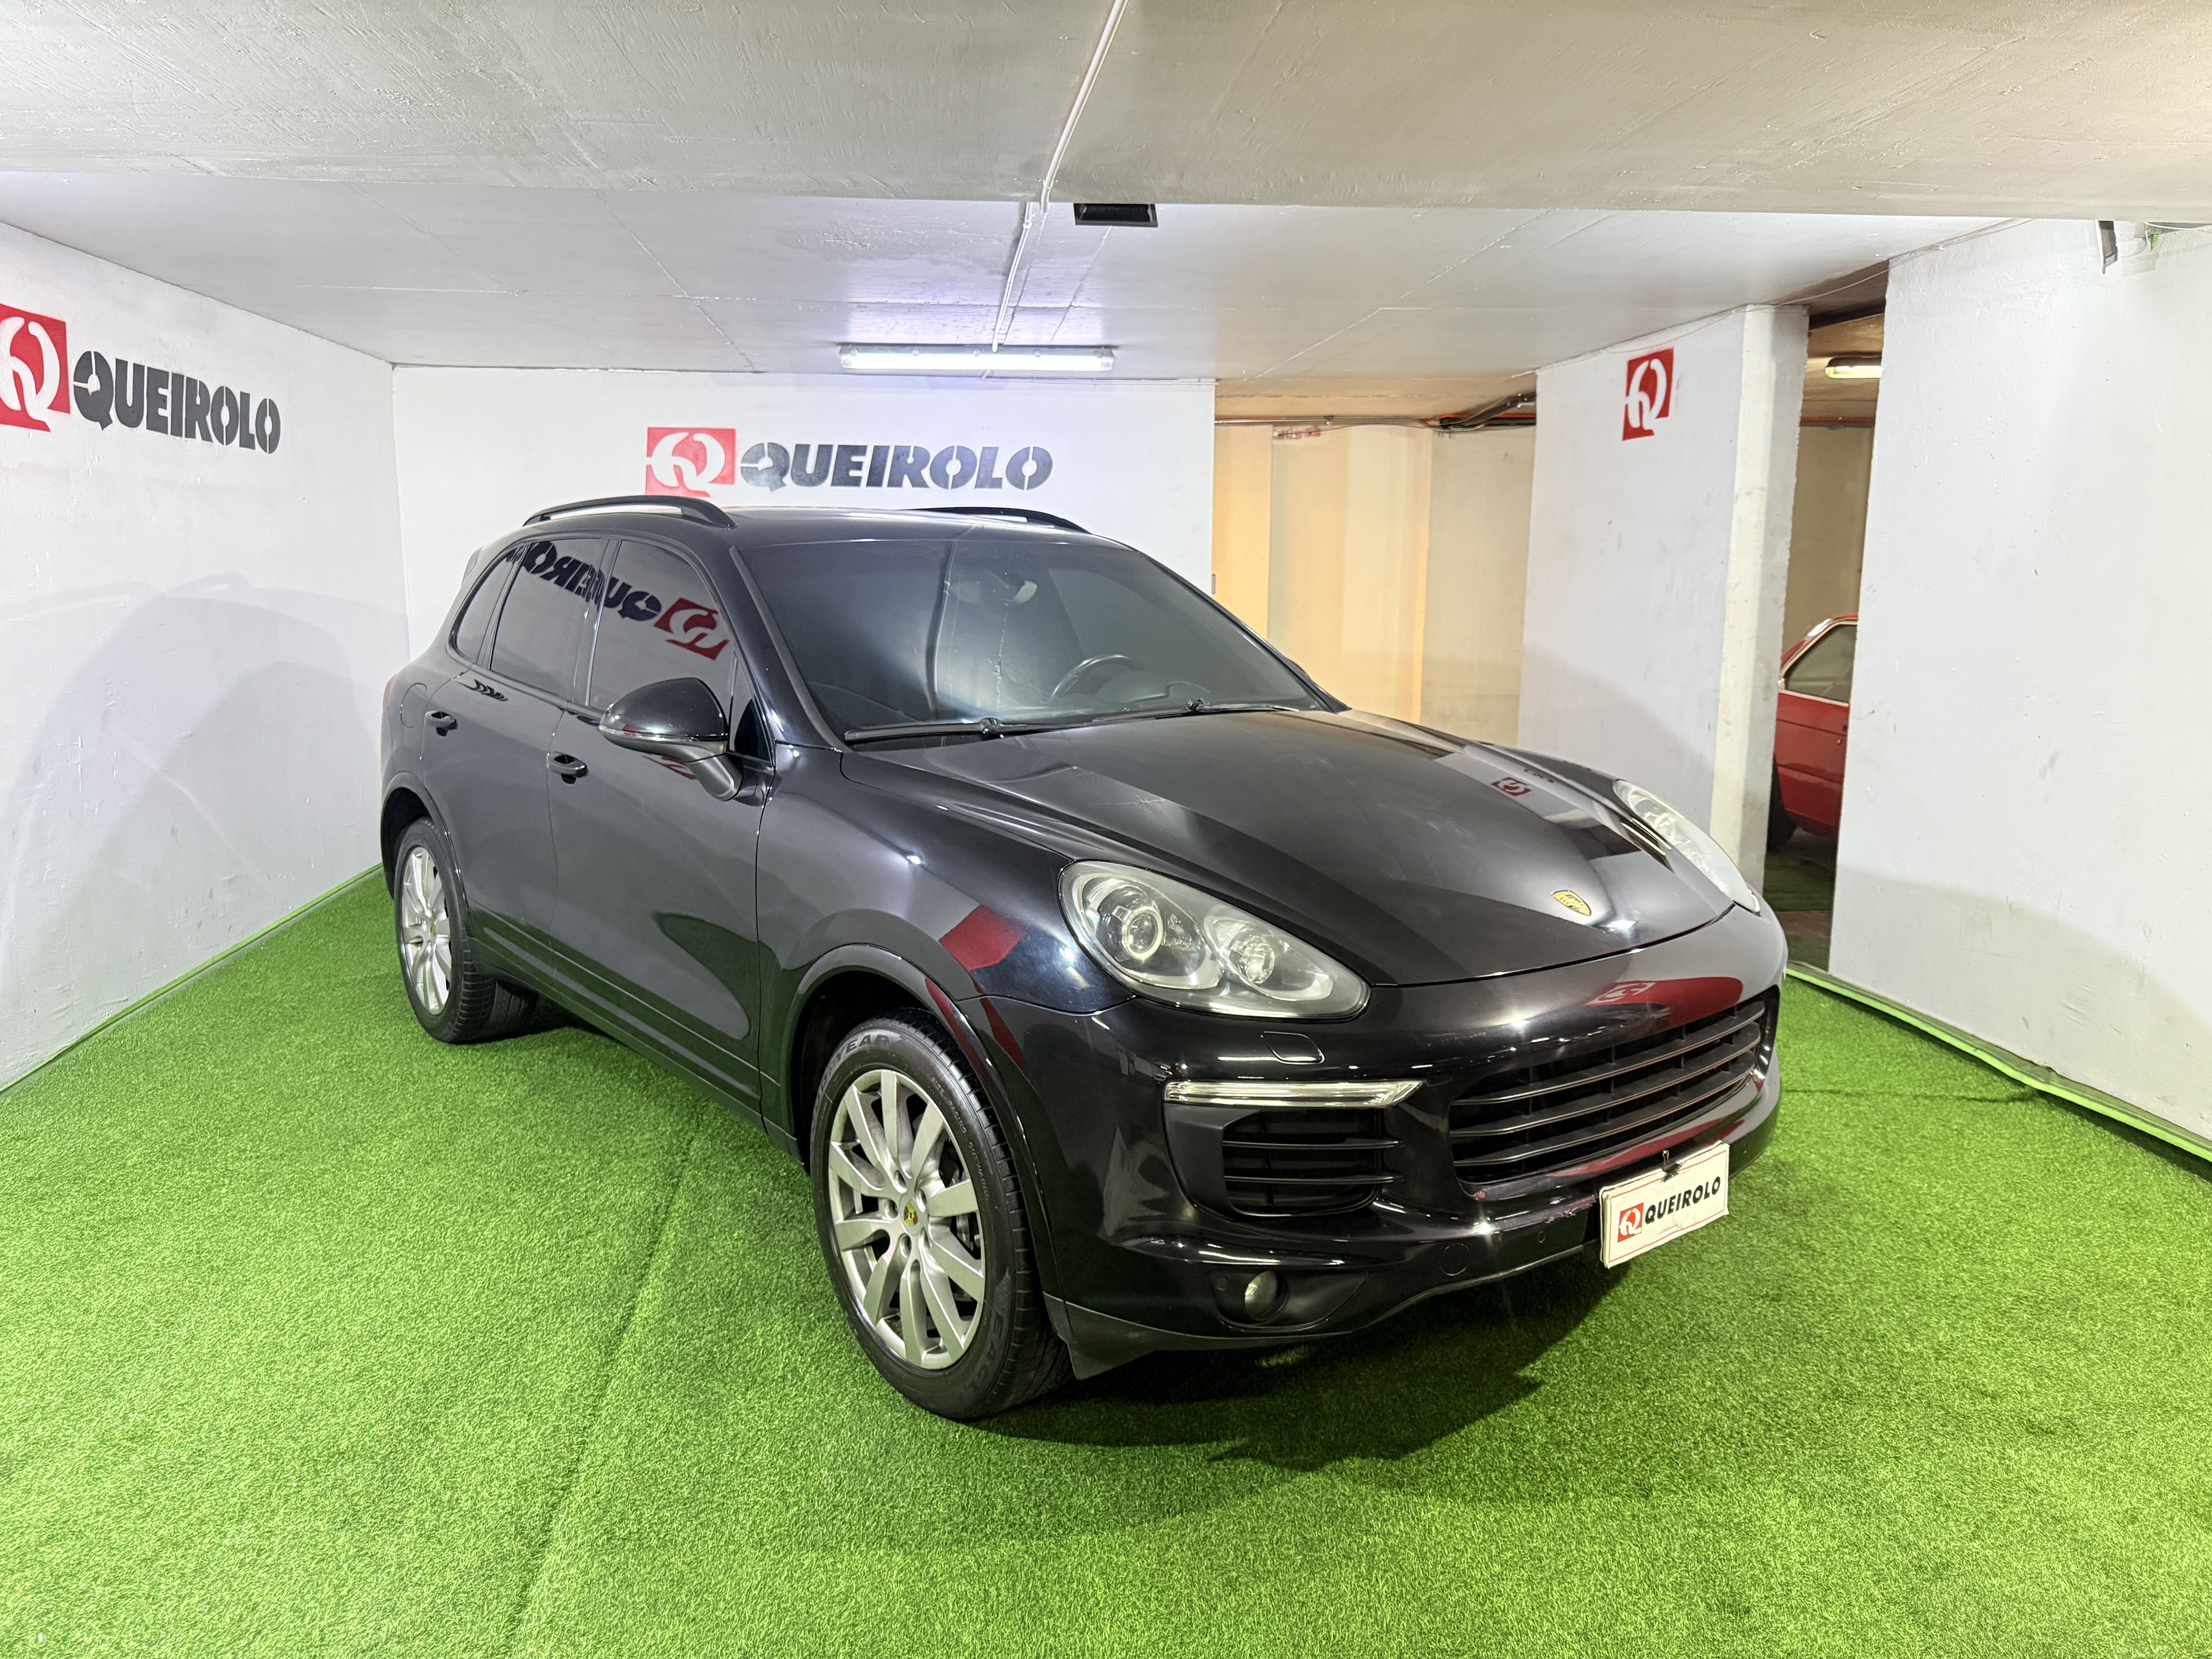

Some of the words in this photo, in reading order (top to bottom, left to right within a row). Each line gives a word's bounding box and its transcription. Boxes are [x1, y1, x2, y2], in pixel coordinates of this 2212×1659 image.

[73, 350, 281, 454] QUEIROLO
[740, 442, 1053, 492] QUEIROLO
[1645, 1176, 1721, 1224] QUEIROLO
